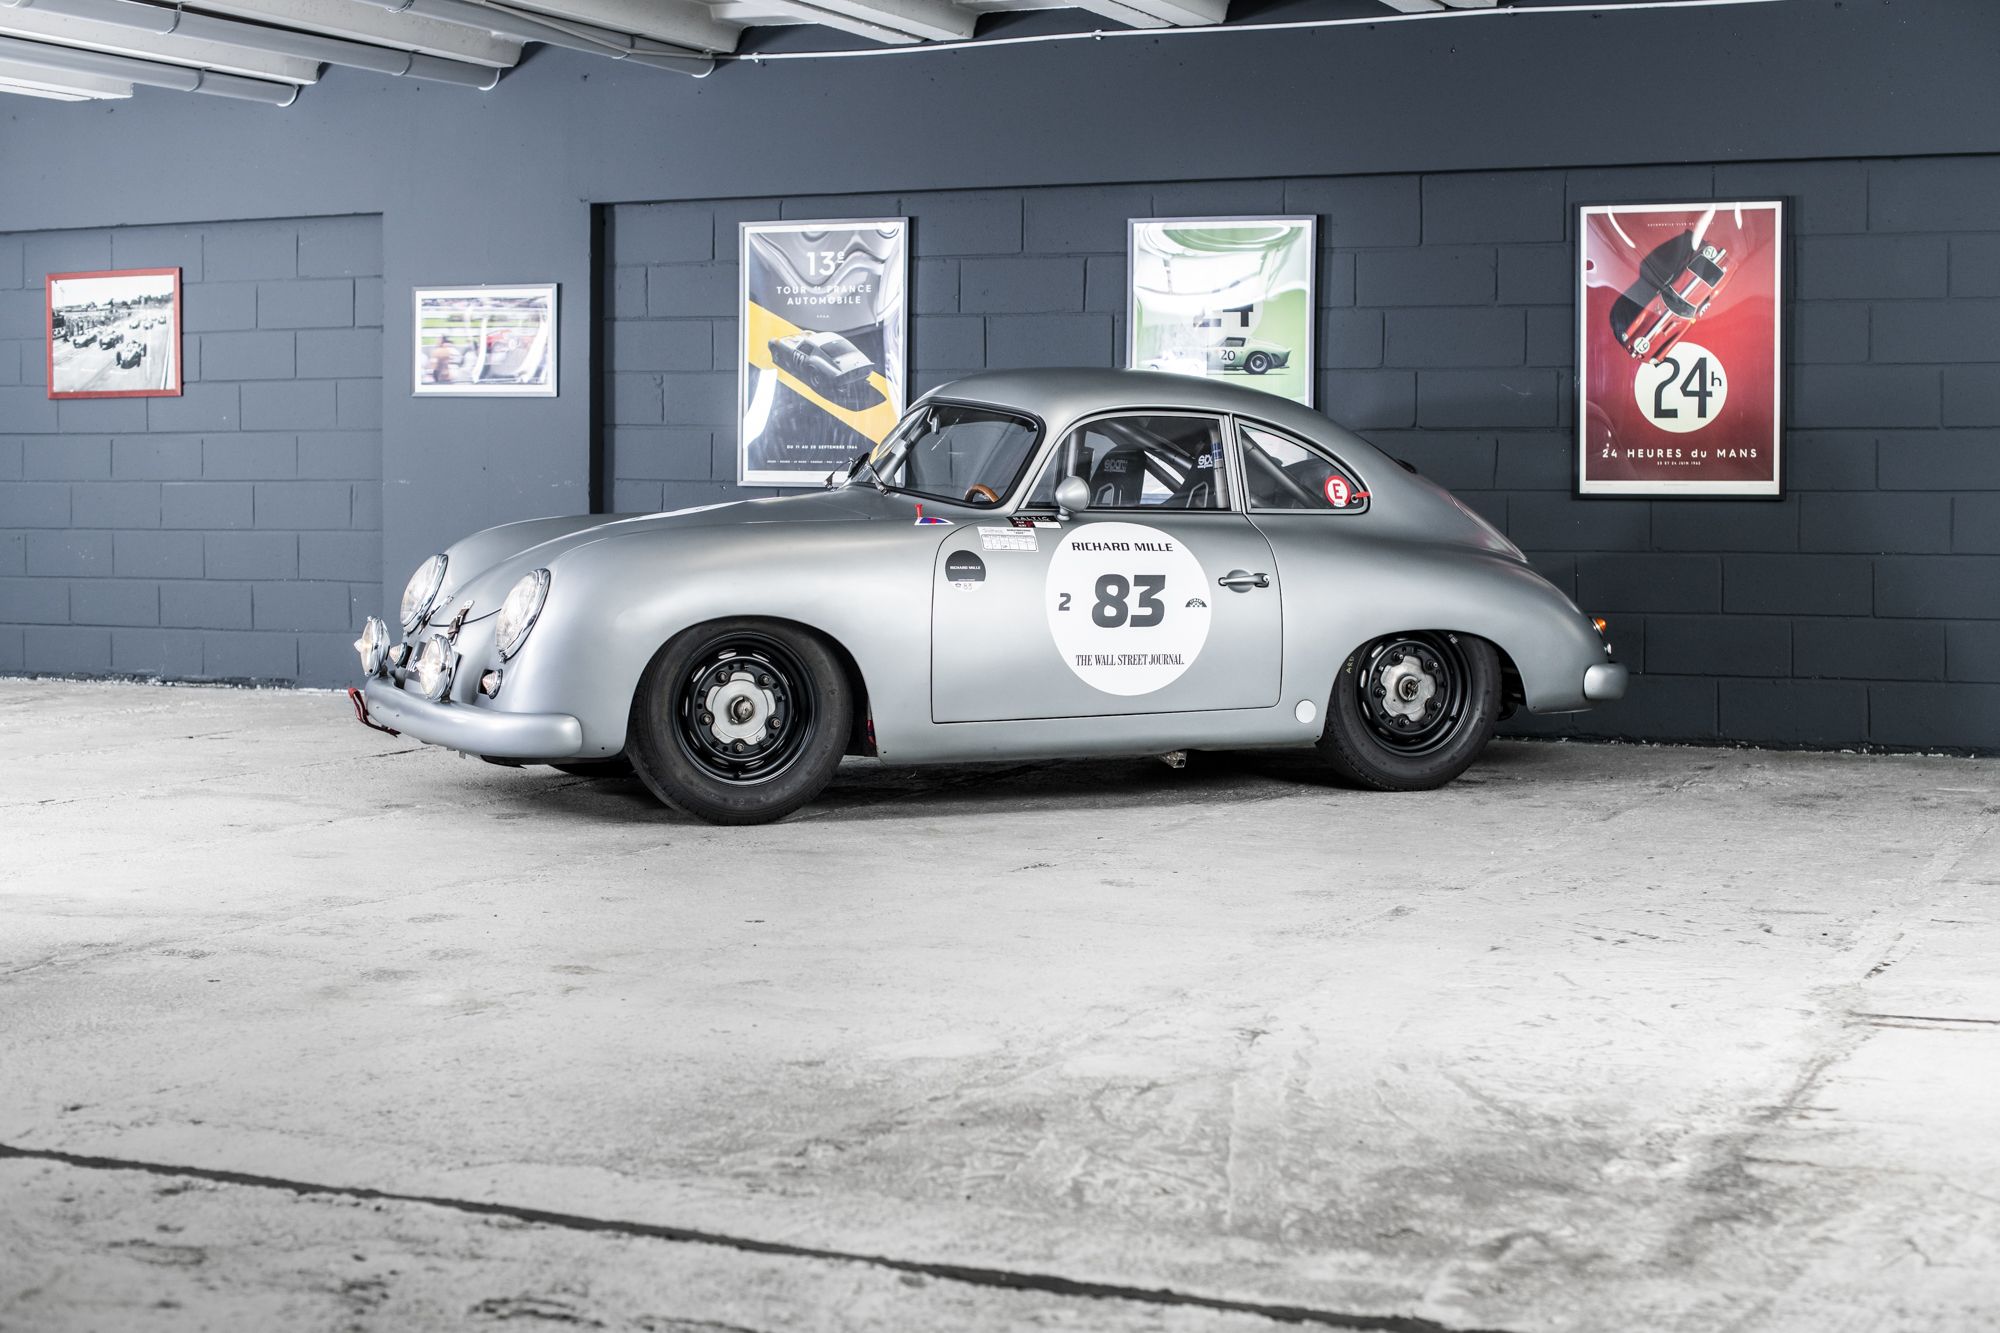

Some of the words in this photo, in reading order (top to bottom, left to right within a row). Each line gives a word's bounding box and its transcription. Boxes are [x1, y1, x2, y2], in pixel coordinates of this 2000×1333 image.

[776, 285, 807, 295] TOUR
[826, 284, 872, 294] FRANCE
[787, 295, 861, 306] AUTOMOBILE
[1221, 350, 1235, 361] 20
[1602, 450, 1618, 459] 24
[1627, 449, 1683, 459] HEURES
[1691, 449, 1708, 458] du
[1717, 448, 1758, 458] MANS
[1332, 483, 1343, 500] E
[1071, 542, 1130, 551] RICHARD
[1134, 542, 1174, 552] MILLE
[1058, 592, 1072, 611] 2
[1091, 573, 1166, 629] 83
[1075, 654, 1093, 666] THE
[1094, 654, 1116, 666] WALL
[1117, 654, 1149, 666] STREET
